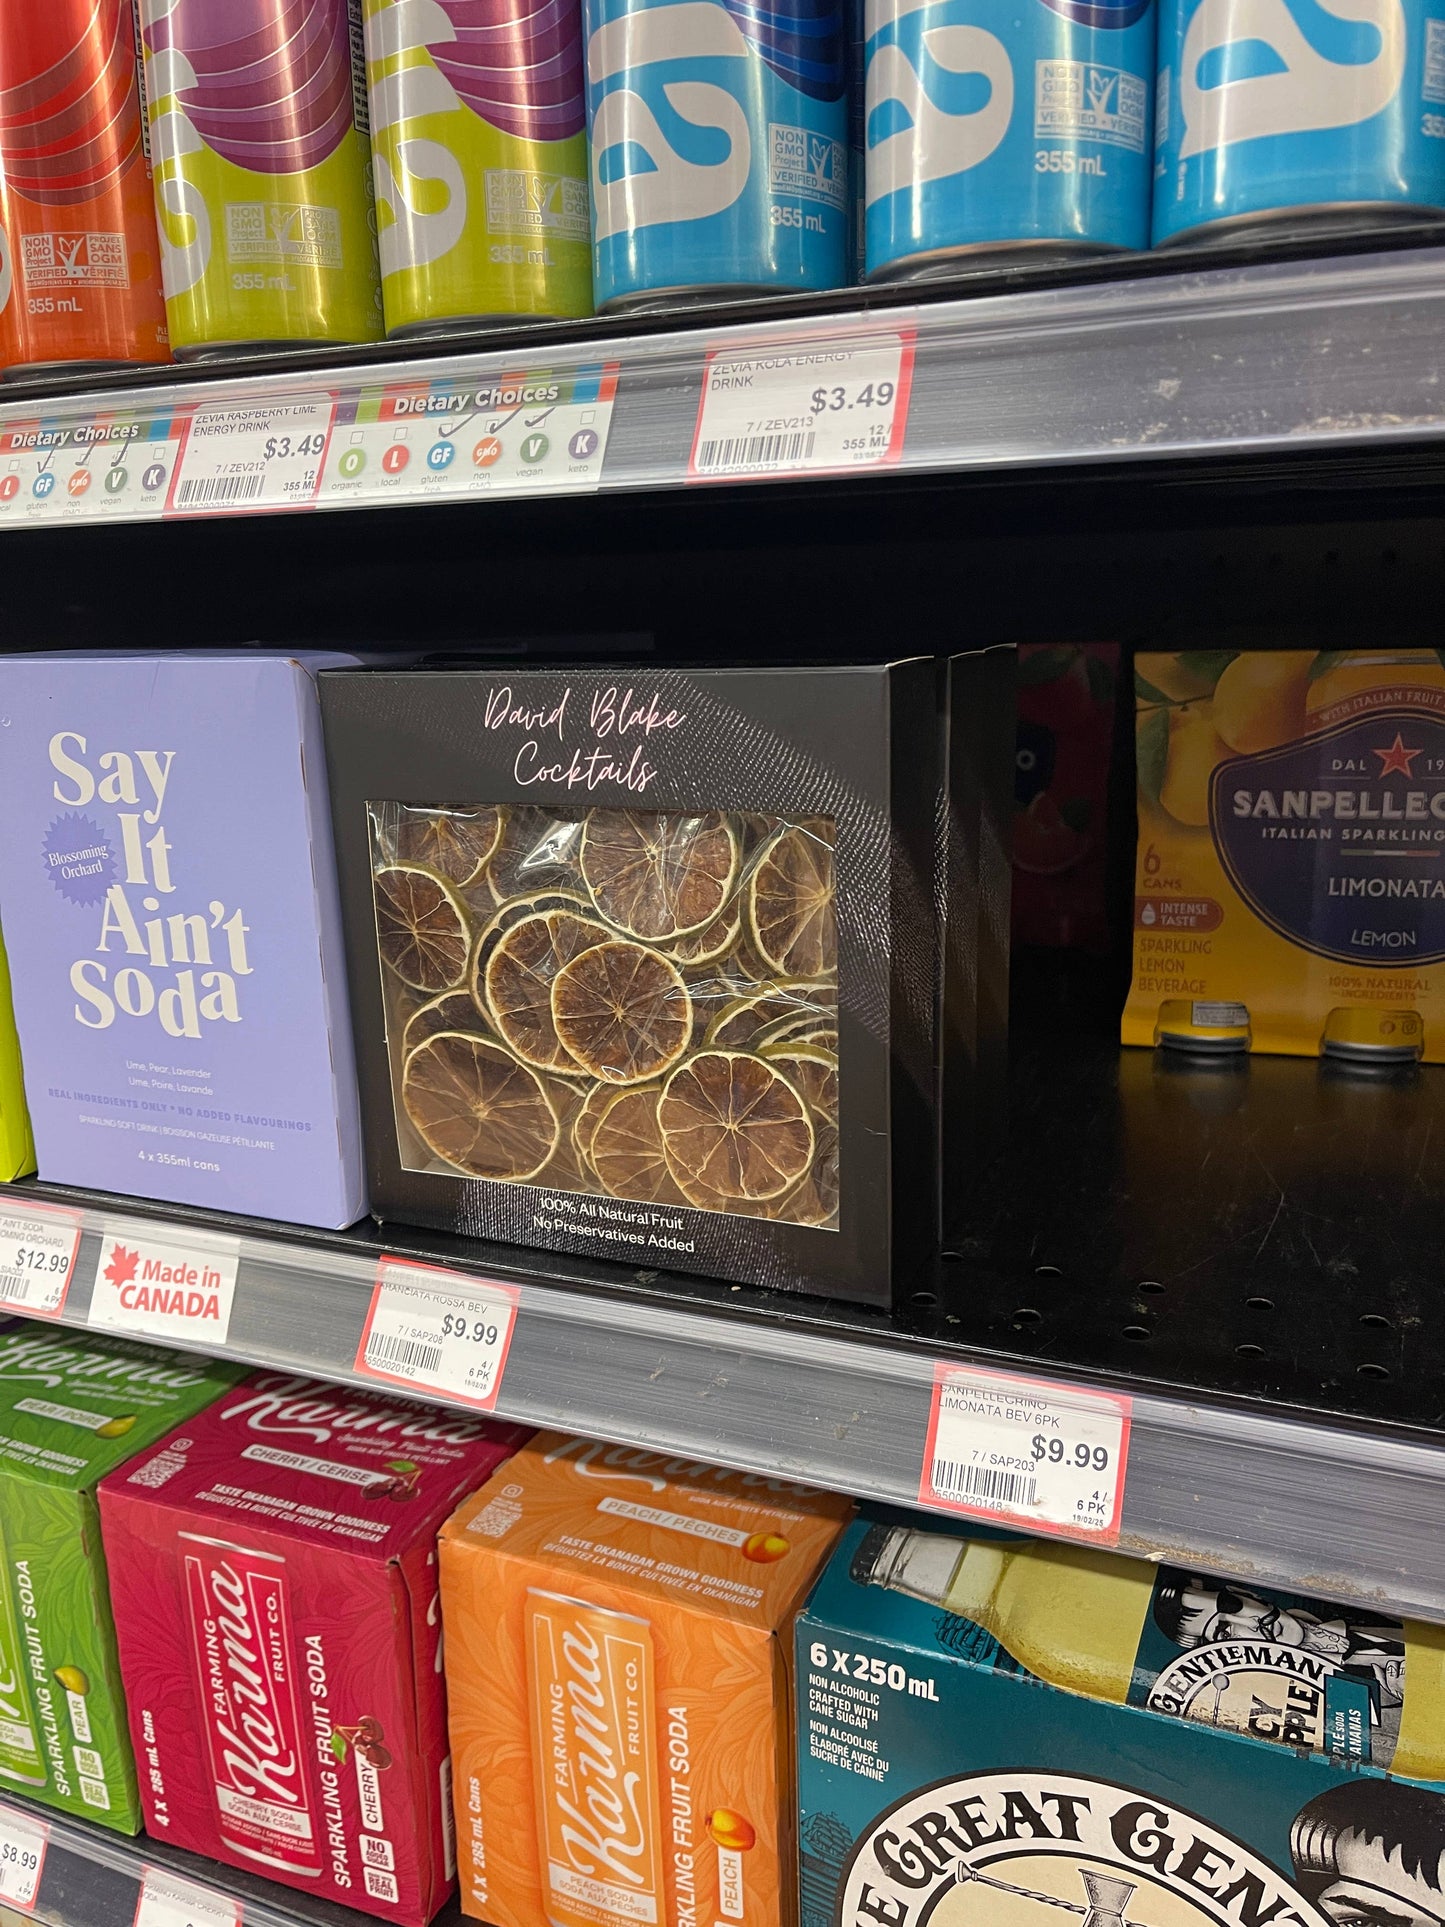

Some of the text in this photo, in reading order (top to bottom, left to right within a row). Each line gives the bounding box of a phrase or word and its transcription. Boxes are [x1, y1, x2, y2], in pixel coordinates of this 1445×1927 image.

[775, 130, 804, 144] NON
[775, 143, 804, 157] GMO
[1035, 151, 1107, 176] 355 mL
[775, 171, 817, 187] VERIFIED
[770, 206, 826, 233] 355 mL
[25, 237, 50, 247] NON
[26, 247, 51, 258] GMO
[90, 243, 121, 254] SANS
[27, 257, 52, 266] Project
[90, 253, 122, 264] OGM
[27, 266, 125, 279] VERIFIED VÉRIFIÉ
[232, 272, 297, 291] 355 mL
[28, 296, 83, 314] 355 mL
[711, 376, 754, 391] DRINK
[393, 384, 559, 415] Dietary Choices
[810, 382, 894, 415] $3.49
[10, 424, 139, 449] Dietary Choices
[194, 421, 271, 437] ENERGY DRINK
[263, 434, 326, 461] $3.49
[528, 439, 542, 458] V
[575, 435, 589, 454] K
[843, 436, 890, 450] 355 ML
[346, 454, 358, 472] O
[390, 450, 400, 467] L
[430, 448, 451, 464] GF
[112, 471, 123, 488] V
[147, 469, 160, 486] K
[420, 474, 448, 485] gluten
[515, 467, 544, 478] vegan
[568, 464, 589, 474] keto
[36, 478, 52, 493] GF
[331, 481, 362, 491] organic
[380, 477, 401, 487] local
[100, 497, 121, 506] vegan
[484, 686, 686, 742] David Blake
[514, 740, 657, 793] Cocktails
[1332, 759, 1367, 771] DAL
[48, 732, 176, 824] Say
[1262, 827, 1445, 841] ITALIAN SPARKLING
[48, 844, 109, 868] Blossoming
[117, 813, 176, 893] It
[61, 859, 104, 880] Orchard
[1328, 877, 1445, 898] LIMONATA
[1160, 902, 1208, 915] INTENSE
[1160, 915, 1196, 927] TASTE
[96, 884, 254, 975] Ain't
[1351, 929, 1416, 948] LEMON
[1140, 938, 1212, 954] SPARKLING
[1139, 958, 1185, 973] LEMON
[1138, 978, 1207, 994] BEVERAGE
[70, 960, 243, 1039] Soda
[48, 1088, 312, 1132] REAL INGREDIENTS ONLY NO ADDED FLAVOURINGS
[138, 1150, 221, 1172] 4 x 355ml cans
[539, 1197, 684, 1230] 100% All Natural Fruit
[534, 1216, 694, 1252] No Preservatives Added
[15, 1248, 69, 1274] $12.99
[142, 1260, 221, 1289] Made in
[119, 1285, 220, 1320] CANADA
[433, 1295, 465, 1309] ROSSA
[467, 1301, 488, 1314] BEV
[441, 1313, 498, 1346] $9.99
[939, 1397, 1061, 1429] LIMONATA BEV 6PK
[250, 1447, 308, 1468] CHERRY
[316, 1461, 372, 1483] CERISE
[972, 1450, 978, 1461] 7
[989, 1454, 1036, 1472] SAP203
[1030, 1434, 1109, 1471] $9.99
[1077, 1501, 1106, 1515] 6 PK
[605, 1501, 661, 1522] PEACH
[673, 1516, 742, 1543] PÊCHES
[558, 1535, 764, 1598] TASTE OKANAGAN GROWN GOODNESS
[266, 1592, 285, 1682] FRUIT CO.
[16, 1560, 71, 1797] SPARKLING FRUIT SODA
[203, 1618, 228, 1715] FARMING
[810, 1642, 828, 1667] 6
[853, 1654, 906, 1691] 250
[908, 1676, 940, 1702] mL
[211, 1561, 298, 1803] Karma
[809, 1673, 880, 1706] NON ALCOHOLIC
[1150, 1645, 1326, 1716] GENTLEMAN
[624, 1657, 640, 1755] FRUIT CO.
[809, 1688, 879, 1722] CRAFTED WITH
[809, 1701, 868, 1730] CANE SUGAR
[72, 1700, 88, 1736] PEAR
[550, 1683, 568, 1787] FARMING
[809, 1719, 879, 1754] NON ALCOOLISÉ
[305, 1635, 352, 1888] SPARKLING FRUIT SODA
[556, 1621, 645, 1884] Karma
[810, 1733, 889, 1773] ÉLABORÉ AVEC DU
[810, 1747, 885, 1783] SUCRE DE CANNE
[668, 1706, 692, 1847] FRUIT SODA
[360, 1763, 378, 1823] CHERRY
[873, 1790, 1093, 1891] GREAT
[3, 1843, 37, 1871] $8.99
[724, 1857, 738, 1911] PEACH
